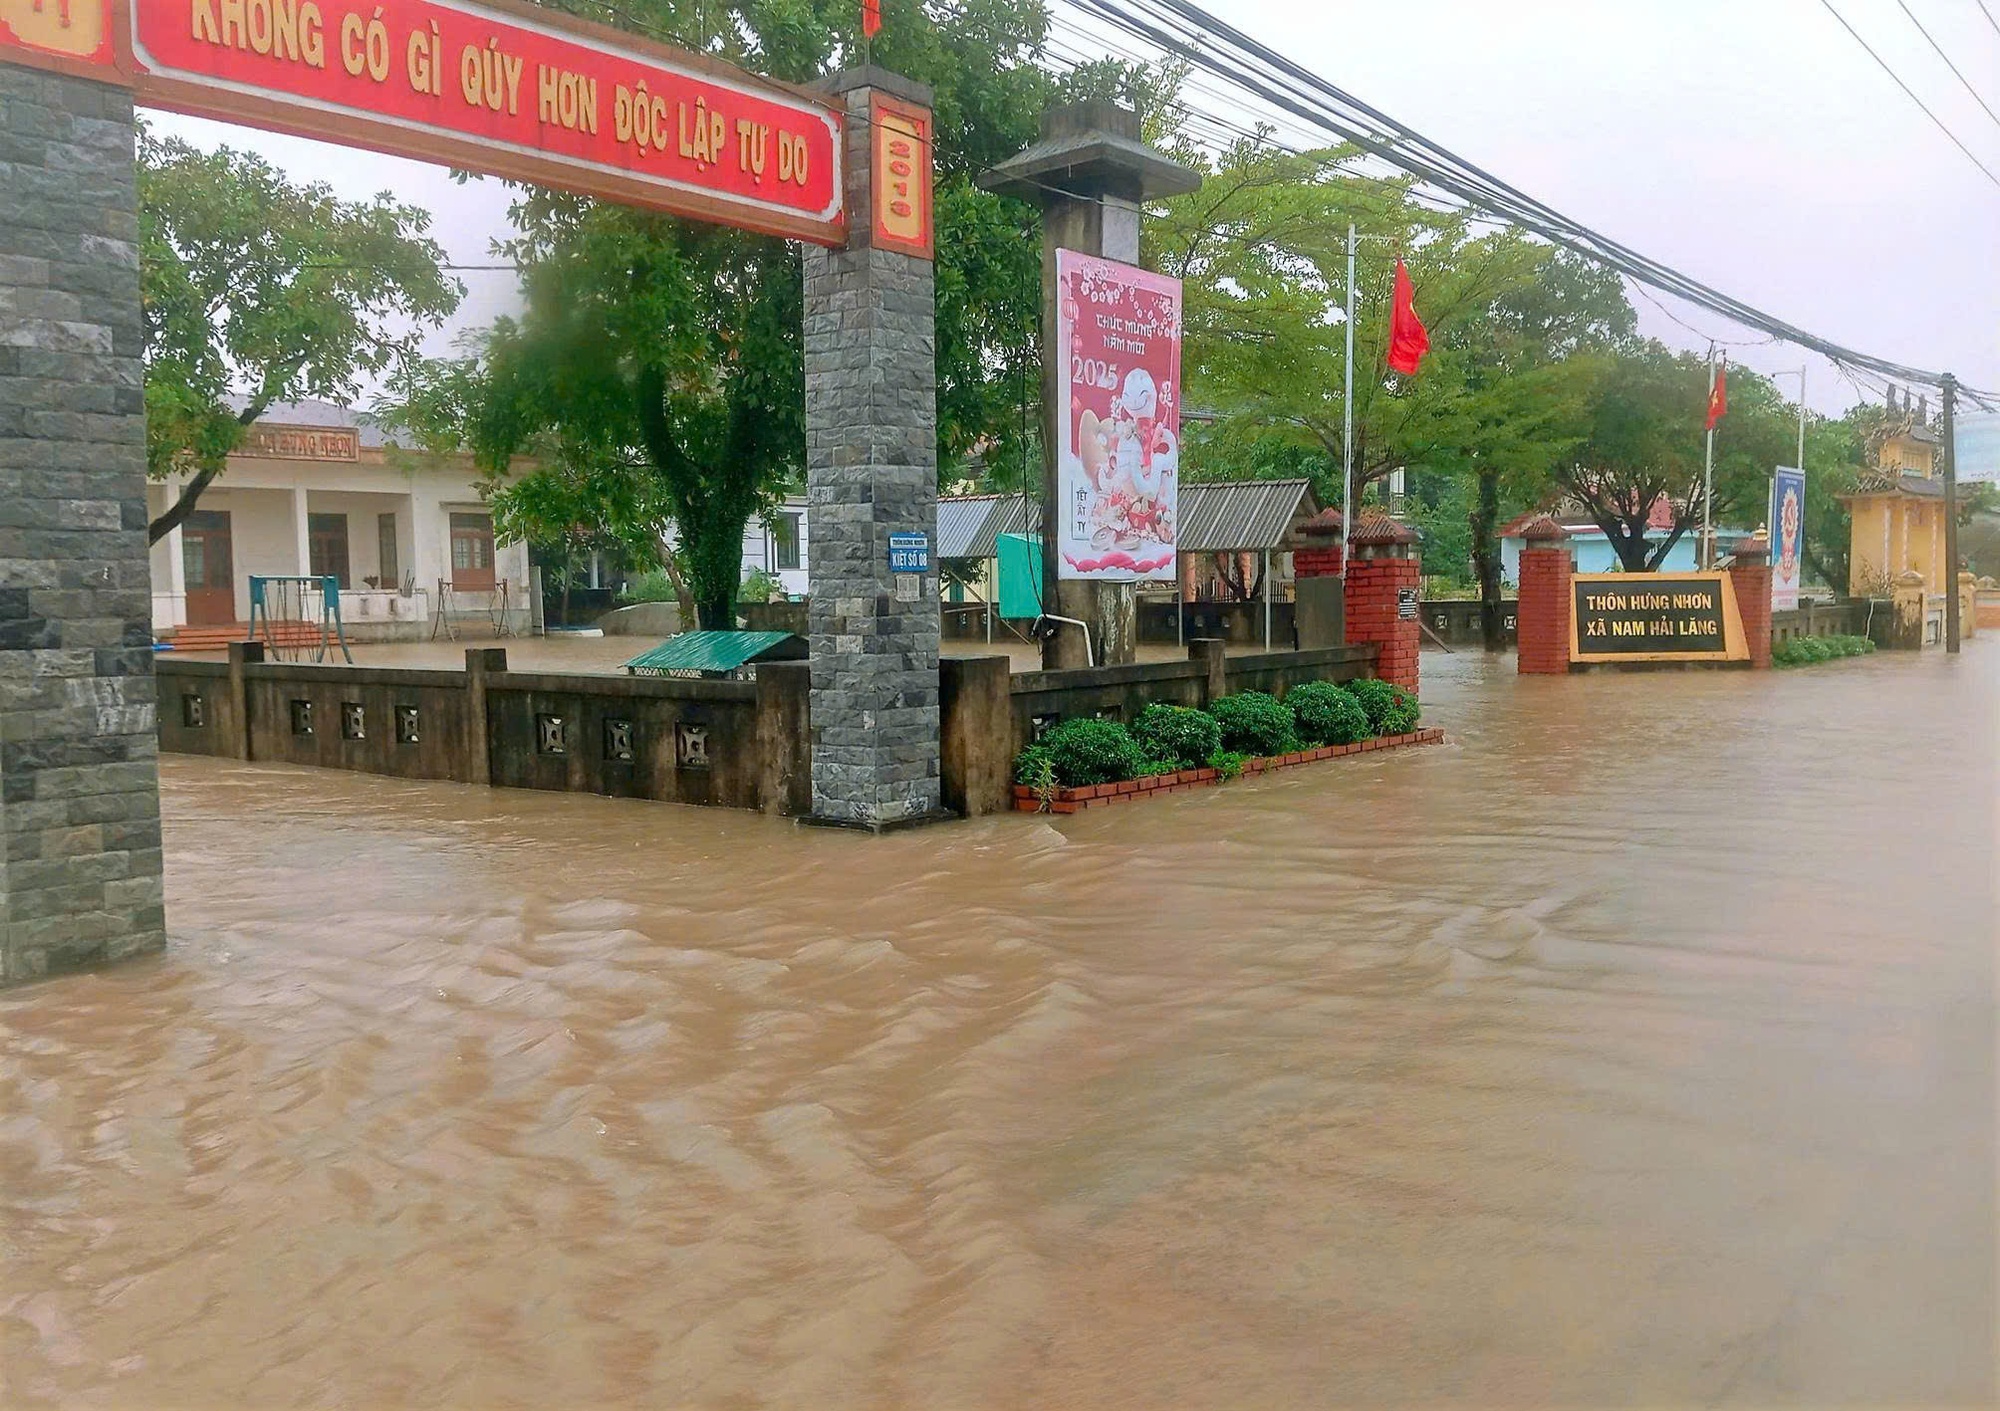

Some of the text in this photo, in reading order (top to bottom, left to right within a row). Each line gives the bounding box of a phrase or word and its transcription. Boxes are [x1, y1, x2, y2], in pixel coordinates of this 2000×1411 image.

[341, 5, 390, 82] CÓ
[407, 18, 441, 96] GÌ
[461, 37, 523, 115] QÚY
[538, 63, 597, 135] HƠN
[614, 79, 668, 158] ĐỘC
[679, 95, 726, 172] LẬP
[736, 118, 769, 184] TỰ
[778, 130, 808, 187] DO
[1072, 355, 1119, 390] 2025
[1586, 592, 1712, 610] THÔN HƯNG NHƠN
[1586, 615, 1718, 636] XÃ NAM HẢI LĂNG
